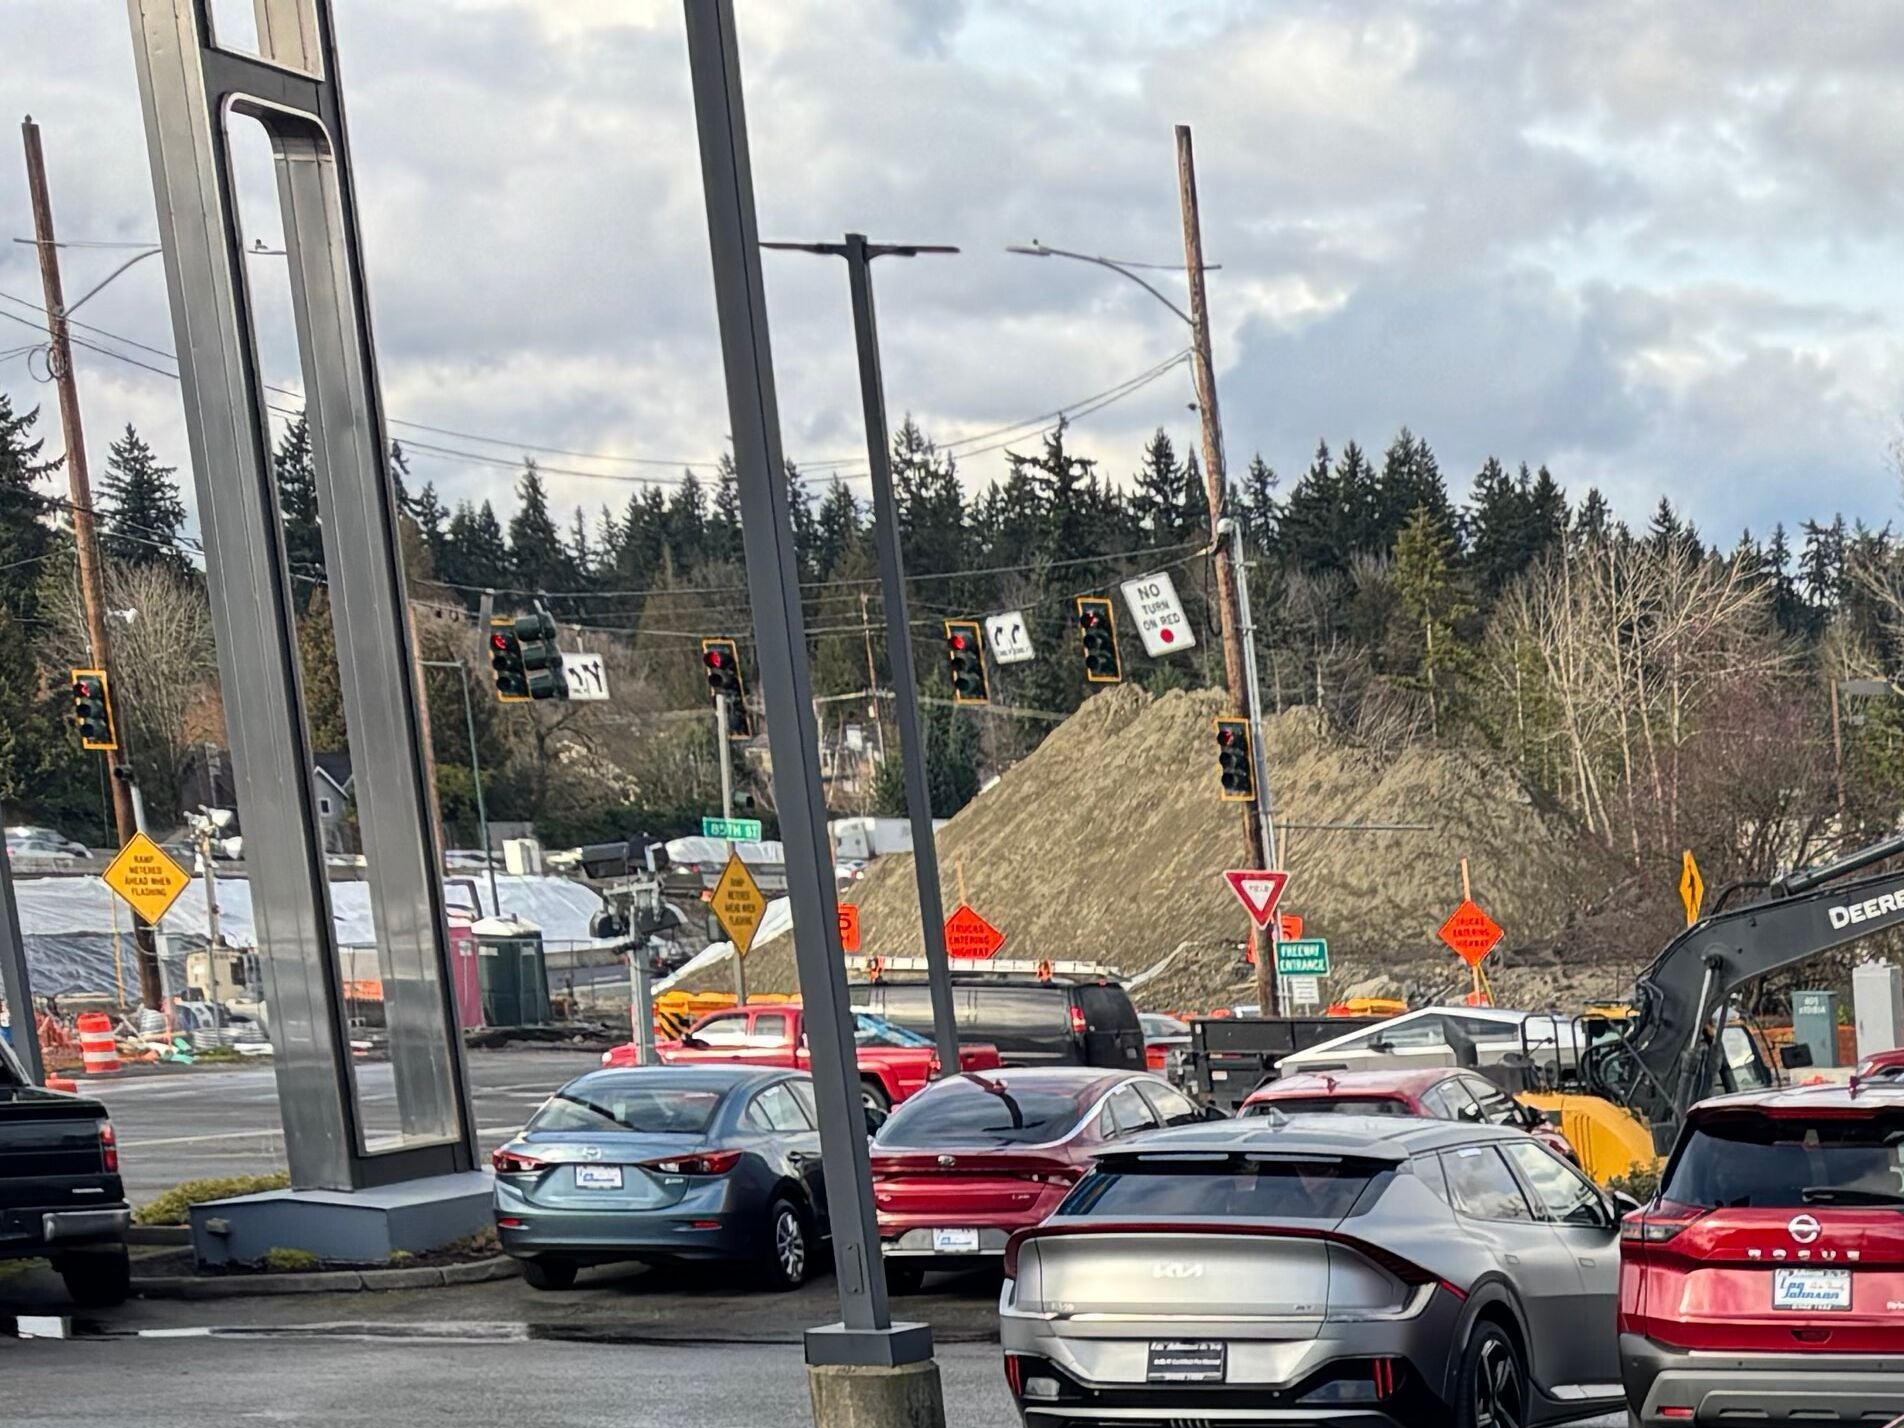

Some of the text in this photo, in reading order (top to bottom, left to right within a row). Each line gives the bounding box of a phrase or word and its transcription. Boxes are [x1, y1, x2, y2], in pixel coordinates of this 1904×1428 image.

[1137, 583, 1161, 601] NO
[1141, 601, 1170, 615] TURN
[1143, 613, 1181, 631] ON RED
[1280, 944, 1320, 958] FREEWAY
[1279, 959, 1325, 972] ENTRANCE
